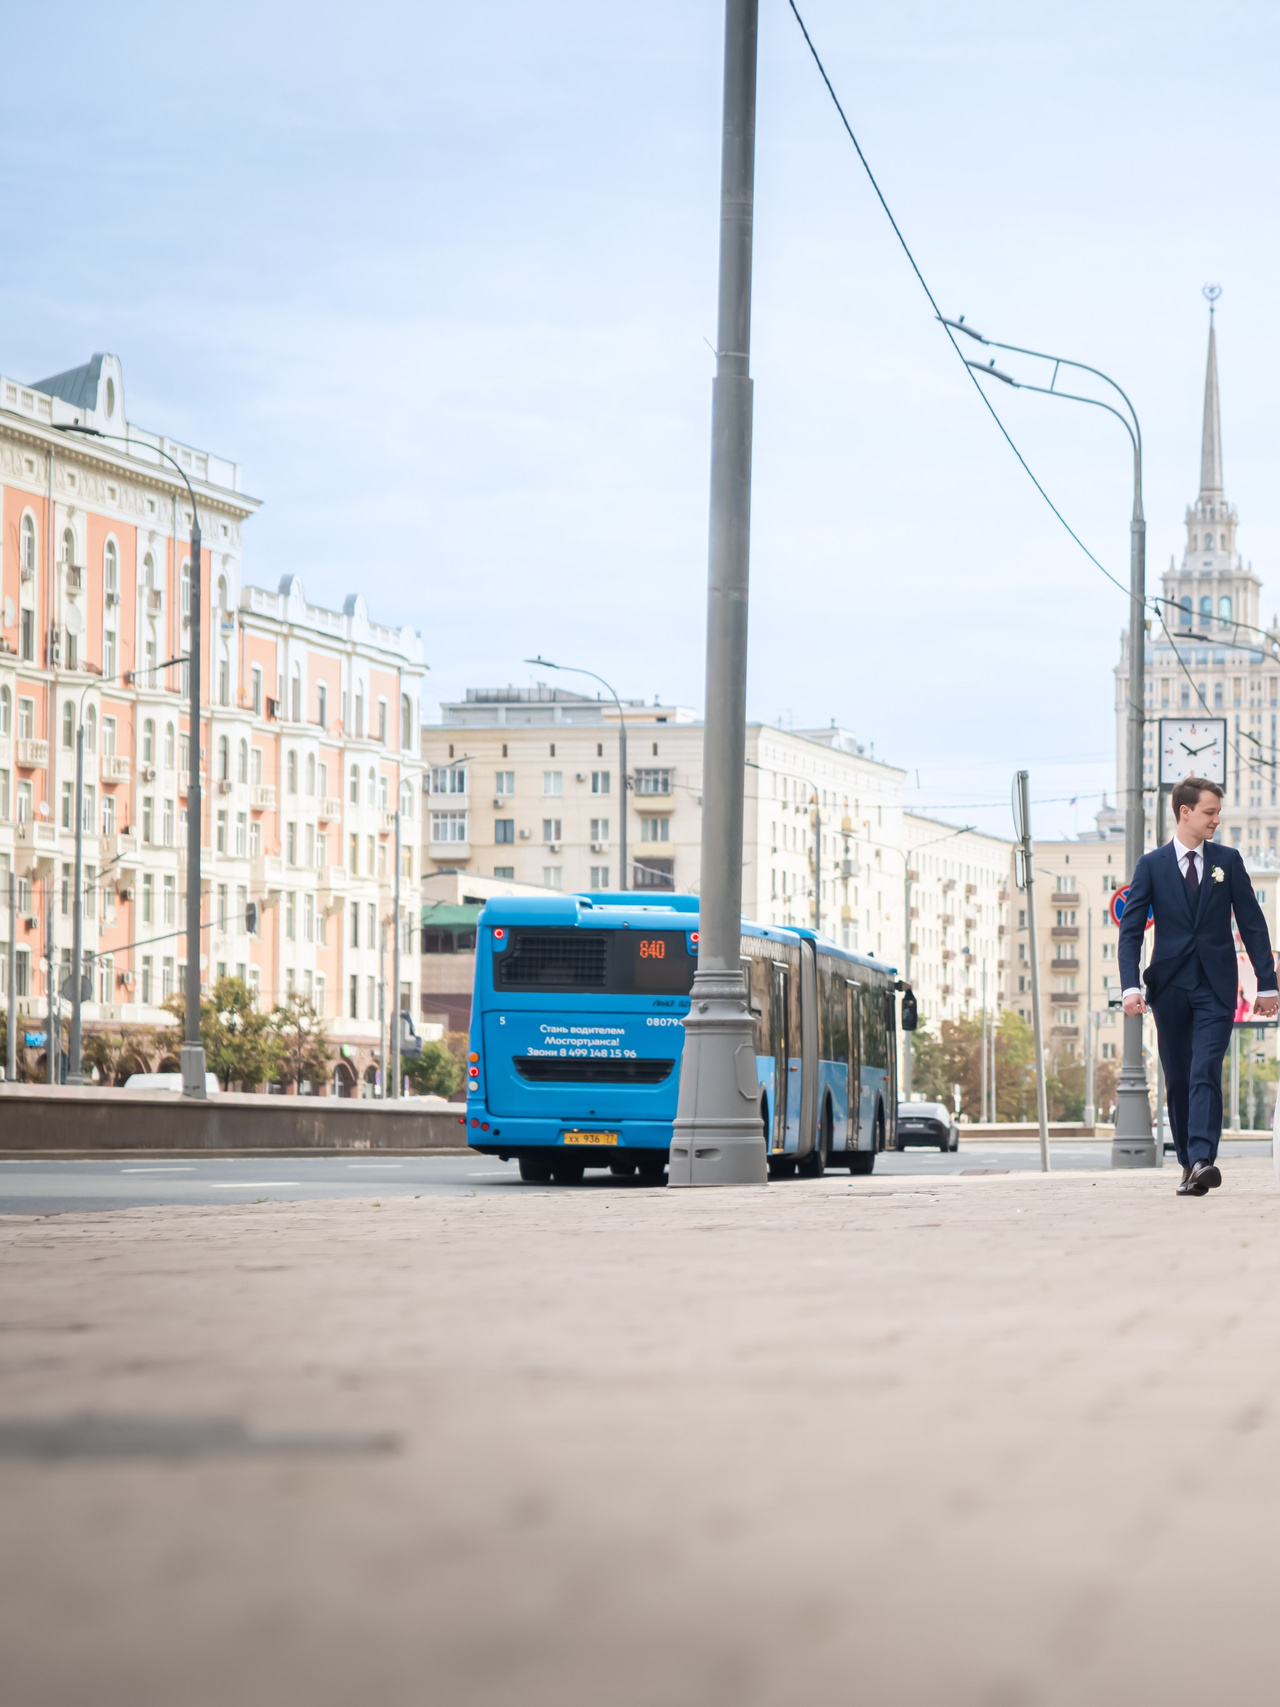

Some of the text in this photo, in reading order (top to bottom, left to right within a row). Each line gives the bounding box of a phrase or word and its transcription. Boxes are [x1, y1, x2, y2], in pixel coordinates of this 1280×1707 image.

[639, 940, 665, 959] 840
[499, 1016, 506, 1026] 5
[539, 1024, 625, 1035] Стань водителем
[544, 1036, 620, 1047] Мосгортранса!
[526, 1047, 637, 1059] Звони 8 499 148 15 96
[583, 1135, 600, 1144] 936
